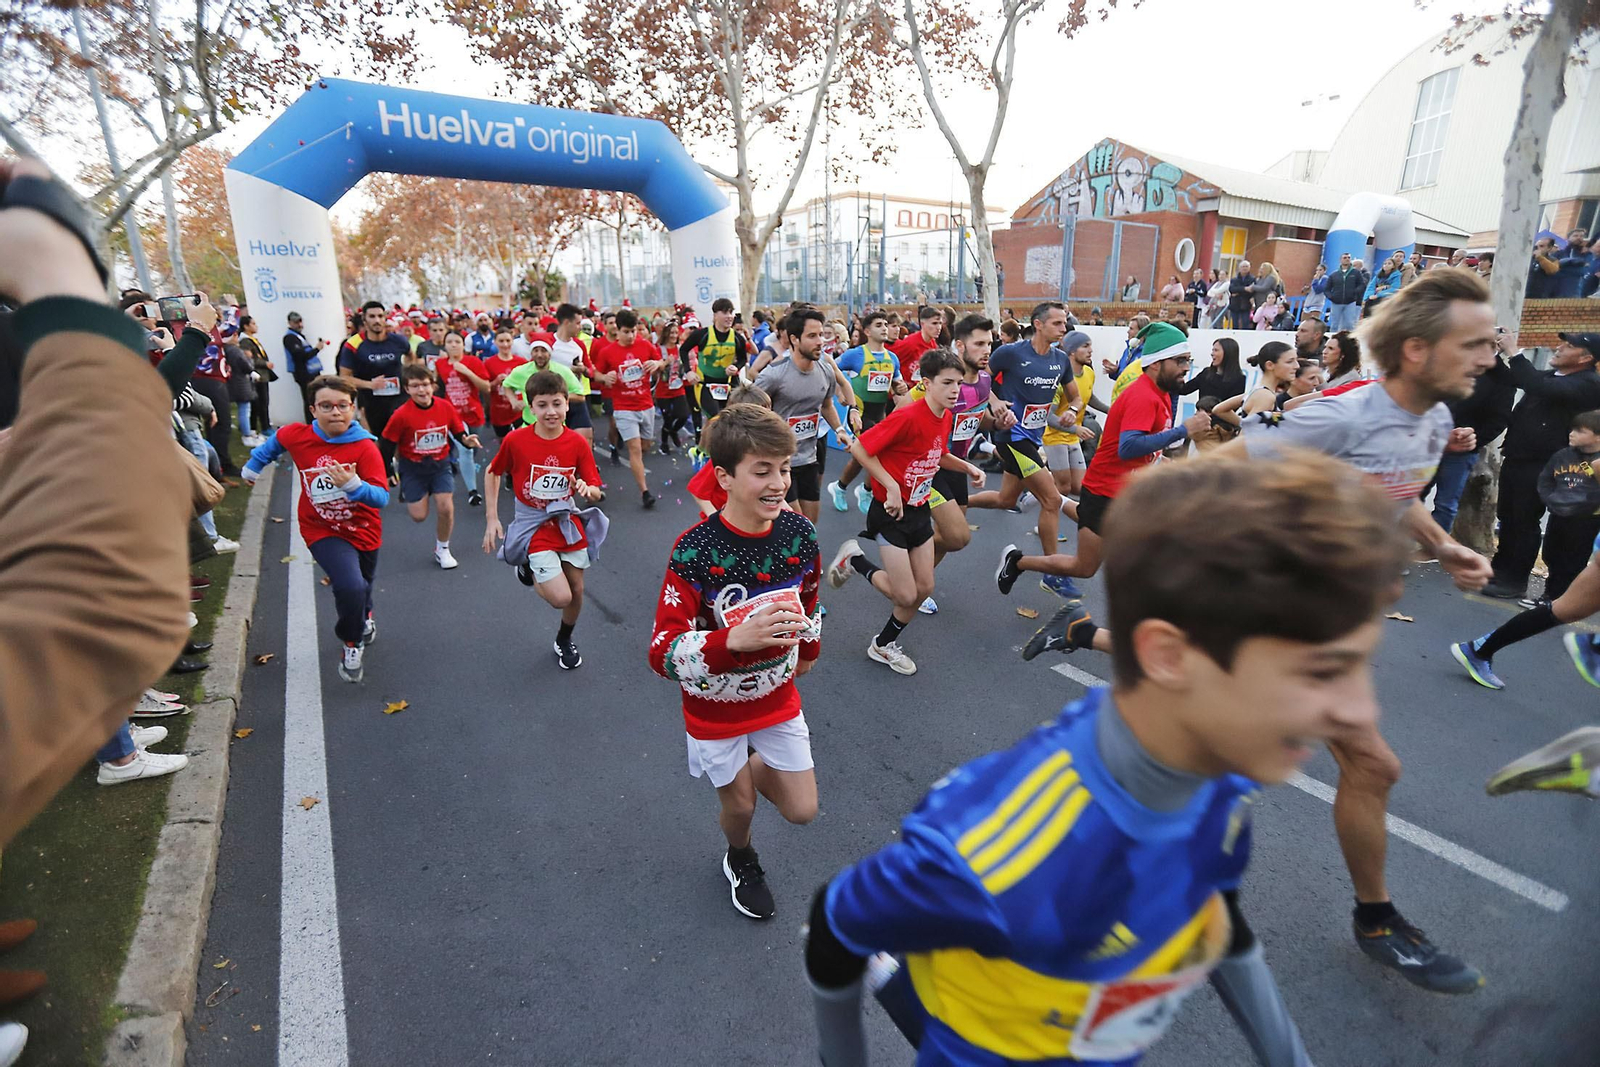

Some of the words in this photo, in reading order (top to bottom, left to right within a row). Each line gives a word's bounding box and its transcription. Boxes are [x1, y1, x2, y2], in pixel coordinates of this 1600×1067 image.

[377, 99, 525, 150] Huelva
[527, 121, 640, 164] original
[248, 239, 320, 258] Huelva
[281, 290, 323, 299] HUELVA
[795, 421, 812, 434] 534
[961, 418, 979, 431] 342
